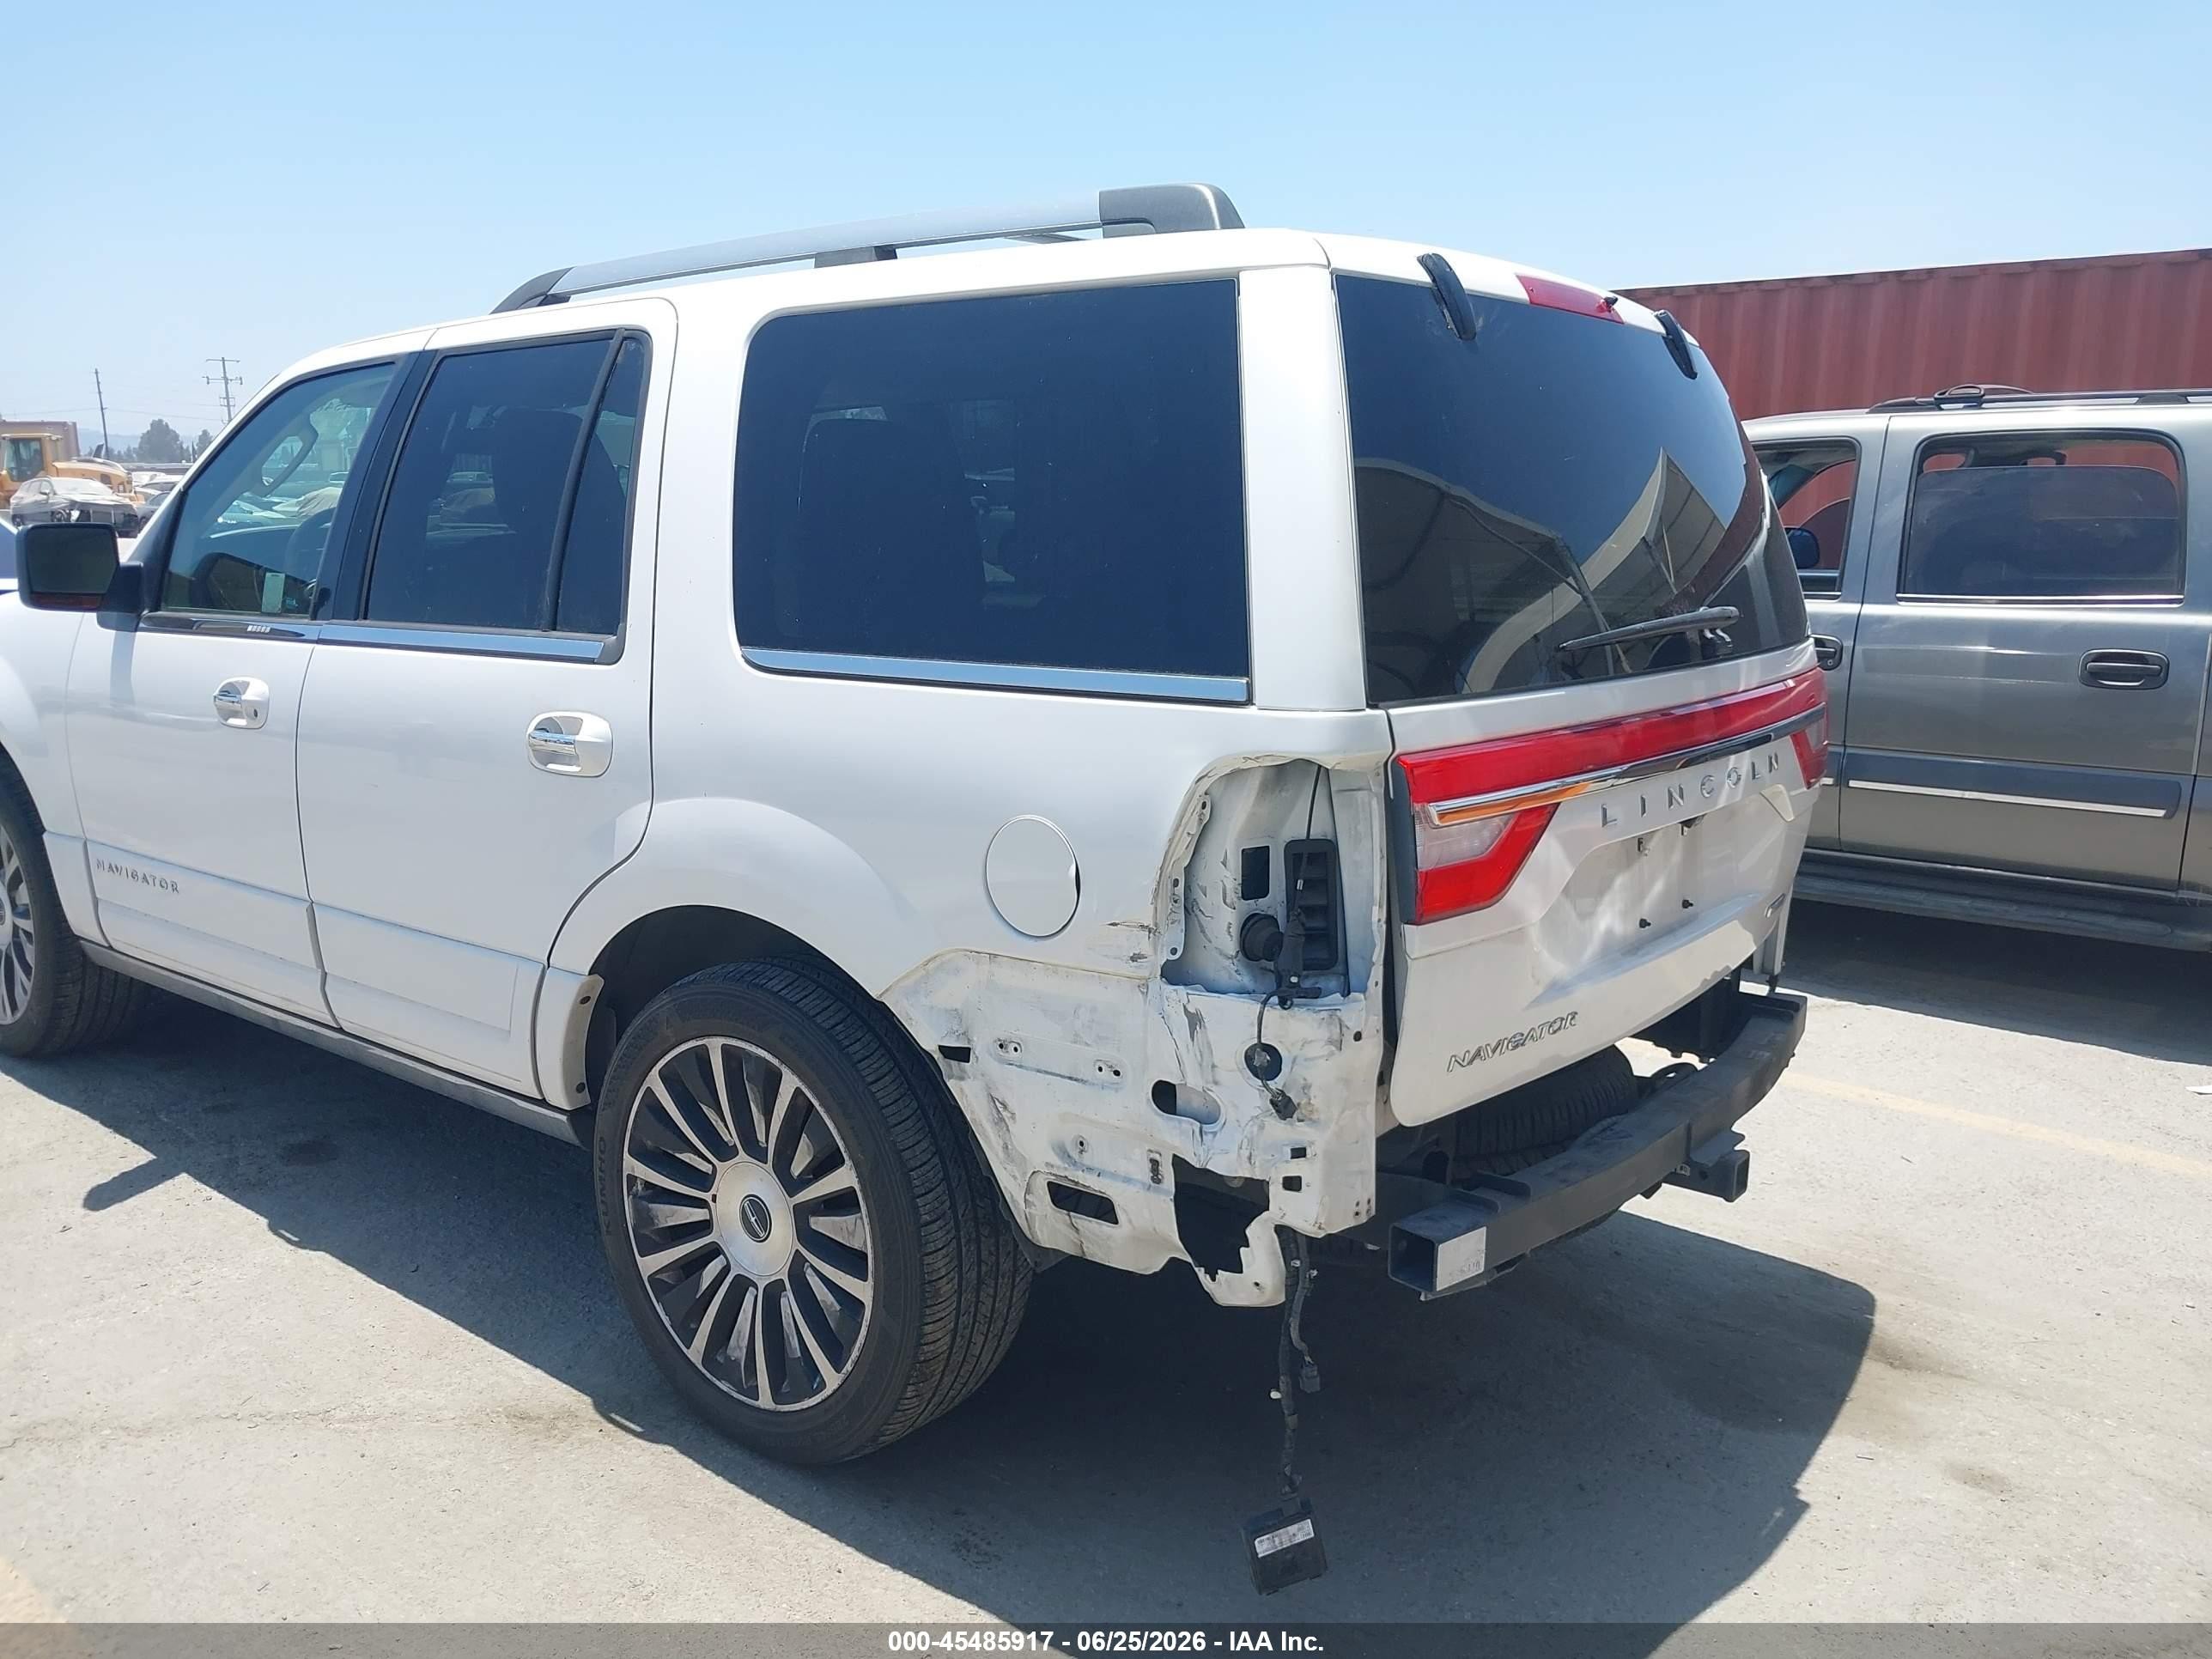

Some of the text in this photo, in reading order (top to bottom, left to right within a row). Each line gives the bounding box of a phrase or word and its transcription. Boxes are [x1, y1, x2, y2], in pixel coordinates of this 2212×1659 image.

[1601, 751, 1780, 828] LINCOLN
[95, 858, 179, 894] NAVIGATOR
[1446, 1011, 1578, 1073] NAVIGATOR
[597, 1136, 612, 1237] KUMHO
